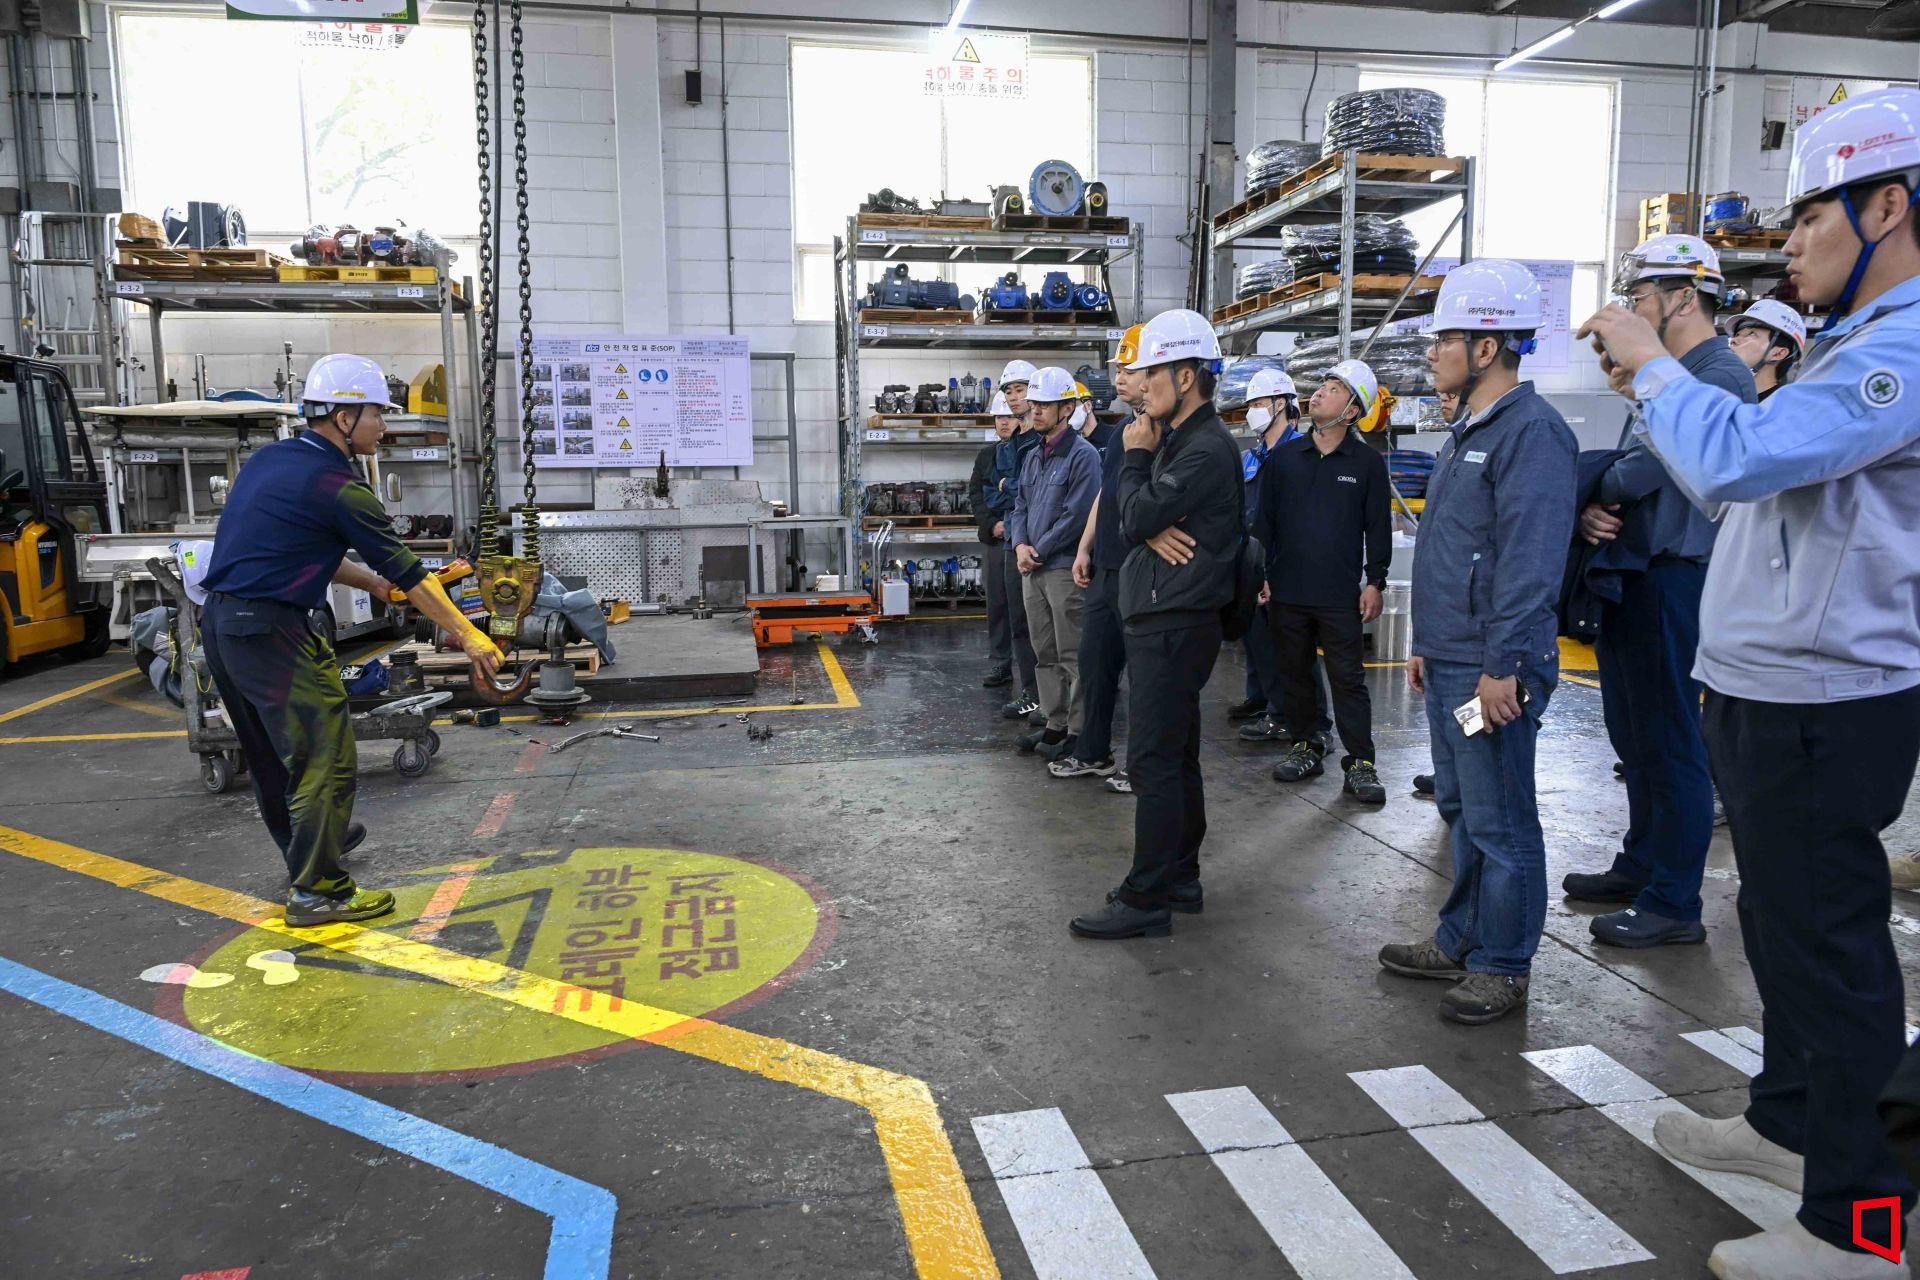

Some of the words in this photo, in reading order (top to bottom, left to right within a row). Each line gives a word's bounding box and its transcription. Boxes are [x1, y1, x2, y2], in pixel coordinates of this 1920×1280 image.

[864, 231, 885, 240] E-4-2
[1108, 237, 1127, 246] E-4-1
[119, 284, 141, 293] F-3-2
[399, 287, 421, 297] F-3-1
[866, 327, 886, 336] E-3-2
[868, 431, 888, 440] E-2-2
[133, 452, 155, 461] F-2-2
[415, 449, 436, 458] F-2-1
[657, 871, 741, 981] 접근금지
